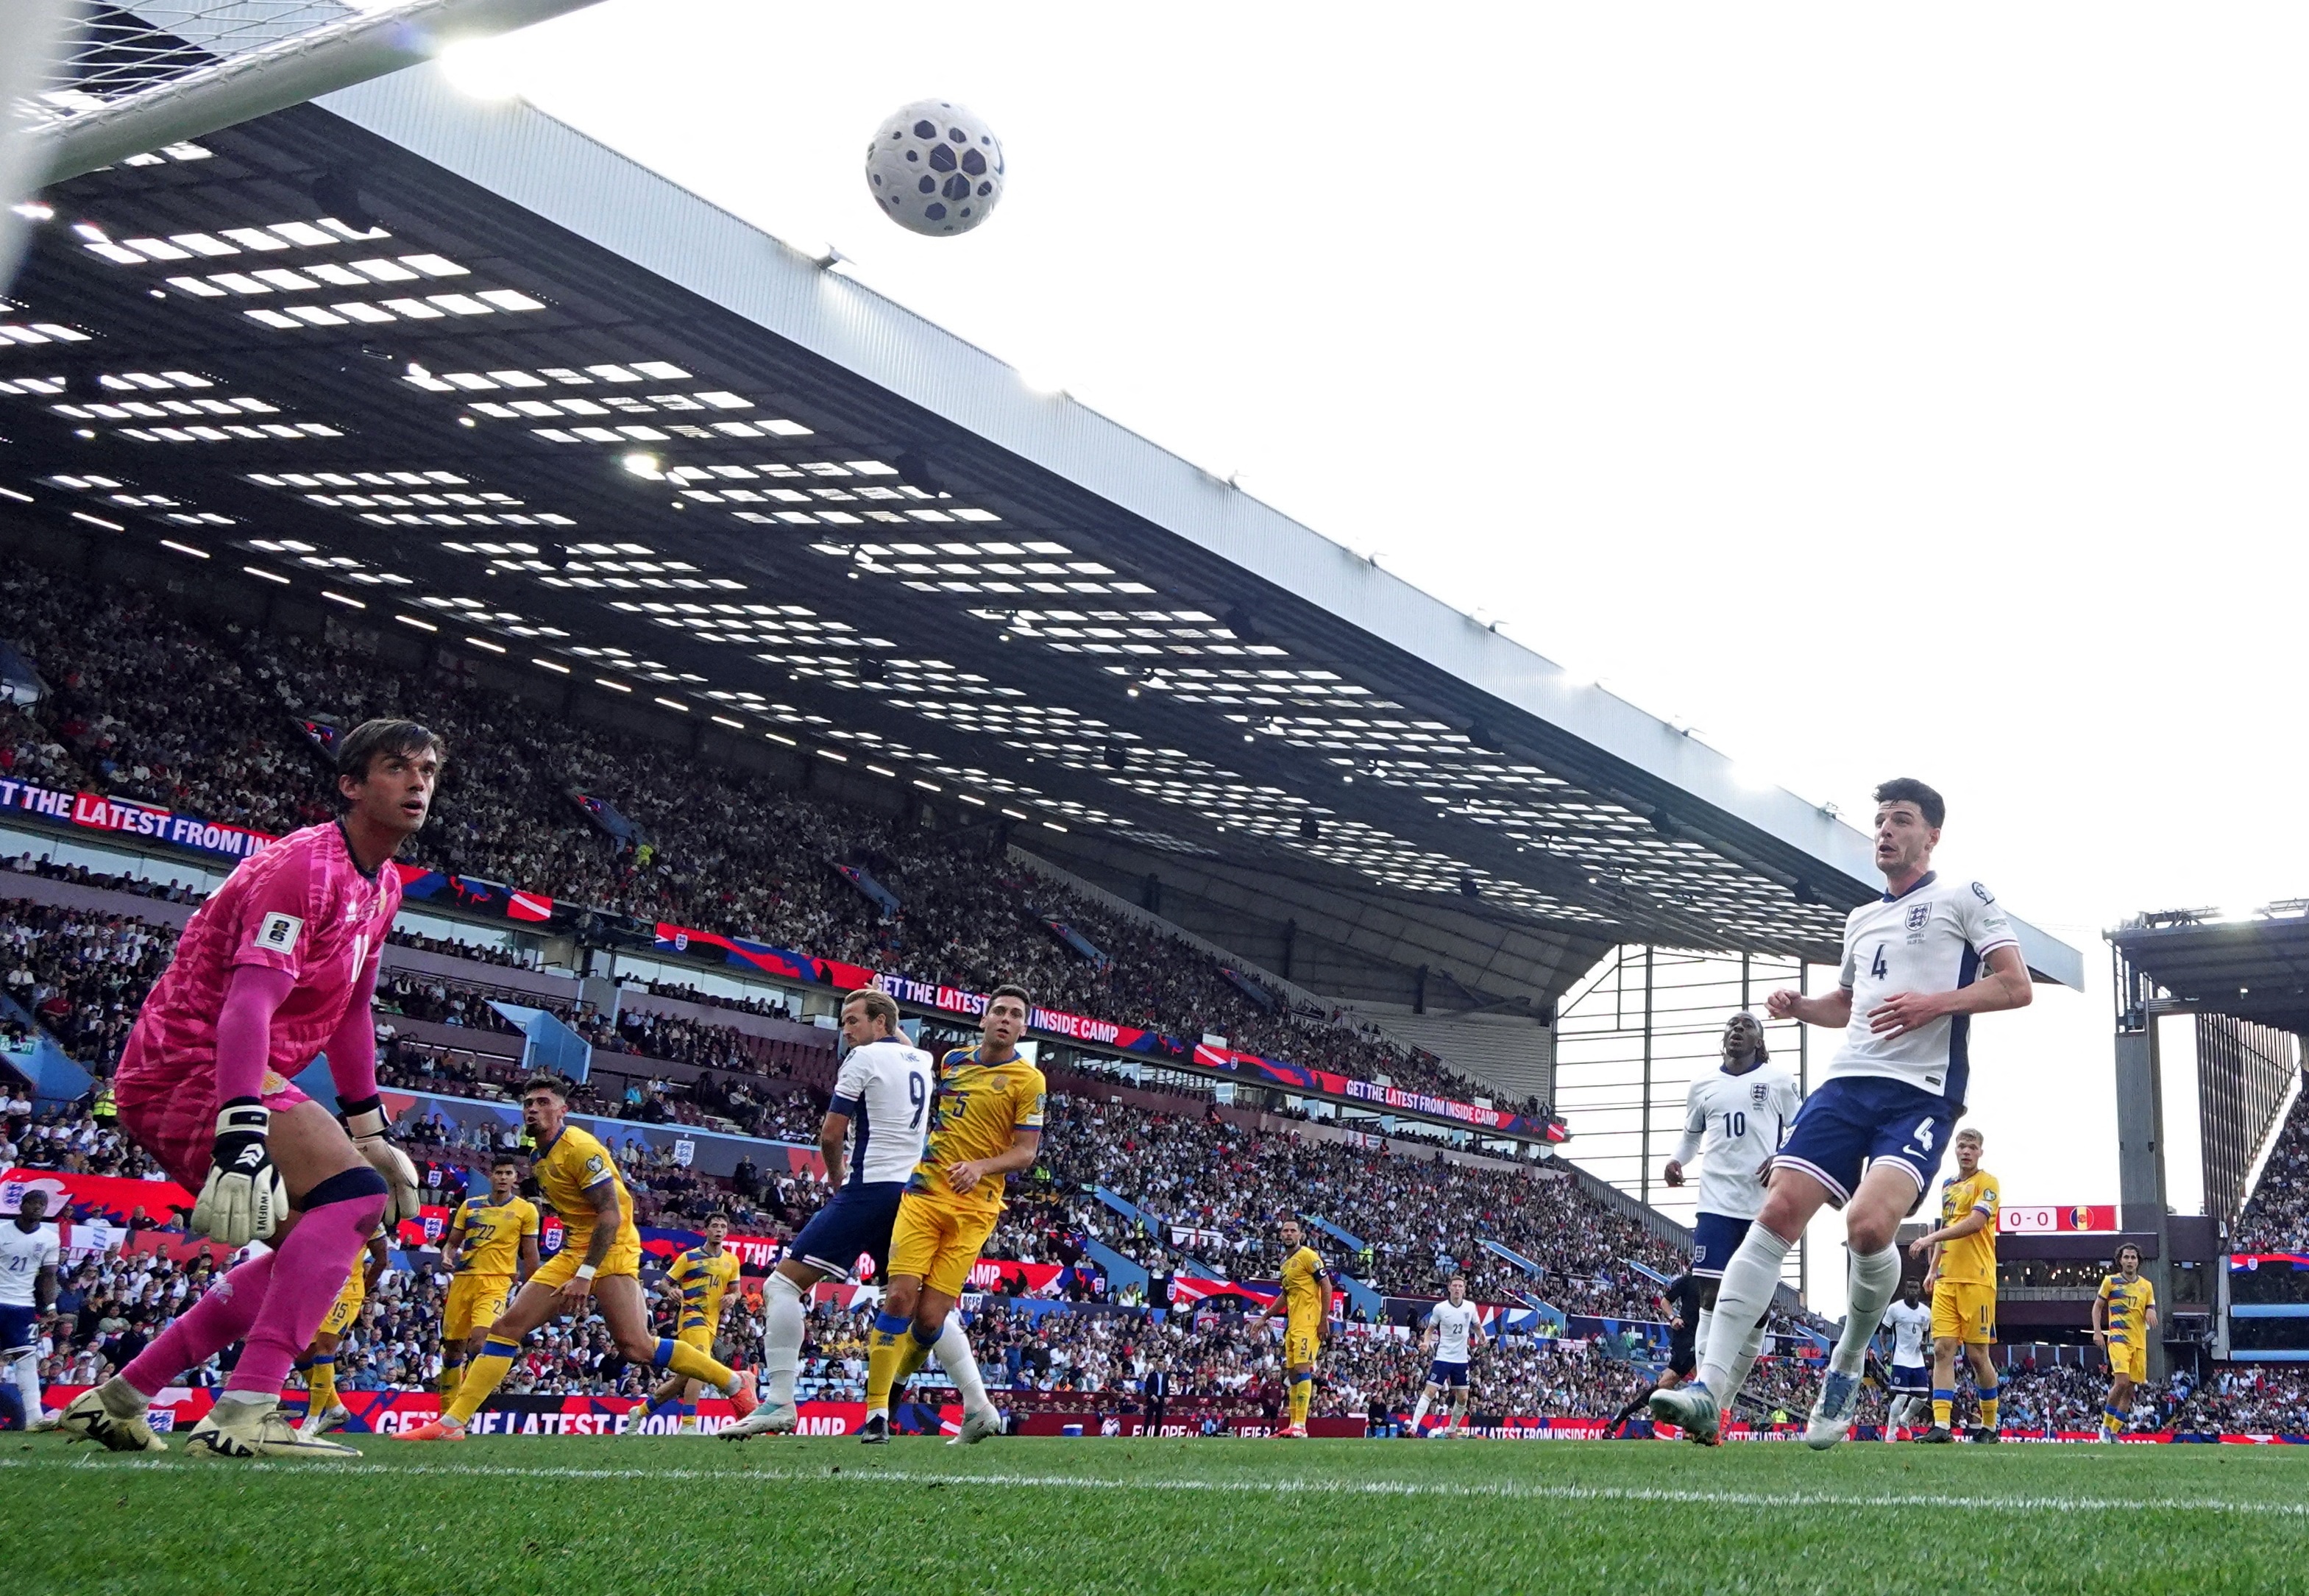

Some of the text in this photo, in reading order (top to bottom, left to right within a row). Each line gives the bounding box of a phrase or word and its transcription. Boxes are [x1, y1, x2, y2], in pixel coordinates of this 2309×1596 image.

[24, 786, 74, 817] THE
[76, 798, 172, 837] LATEST
[173, 819, 242, 854] FROM
[1872, 944, 1888, 981] 4
[906, 980, 933, 1004] THE
[937, 991, 990, 1016] LATEST
[1035, 1009, 1079, 1035] INSIDE
[1081, 1020, 1118, 1043] CAMP
[909, 1071, 925, 1131] 9
[952, 1092, 970, 1117] 5
[1347, 1079, 1499, 1127] GET THE LATEST FROM INSIDE CAMP
[1723, 1112, 1745, 1138] 10
[1914, 1116, 1934, 1151] 4
[257, 1189, 269, 1232] TWOFIVE
[2010, 1213, 2021, 1226] 0
[2037, 1212, 2049, 1226] 0
[478, 1224, 496, 1241] 22
[9, 1256, 28, 1272] 21
[966, 1264, 1001, 1285] AMP
[708, 1274, 719, 1288] 14
[333, 1302, 348, 1319] 15
[1981, 1305, 1988, 1324] 11
[1453, 1324, 1463, 1334] 23
[1301, 1338, 1308, 1351] 3
[466, 1412, 501, 1434] HE
[506, 1413, 610, 1435] LATEST
[797, 1416, 846, 1435] AMP
[1523, 1427, 1553, 1439] FROM
[1554, 1427, 1586, 1440] INSIDE
